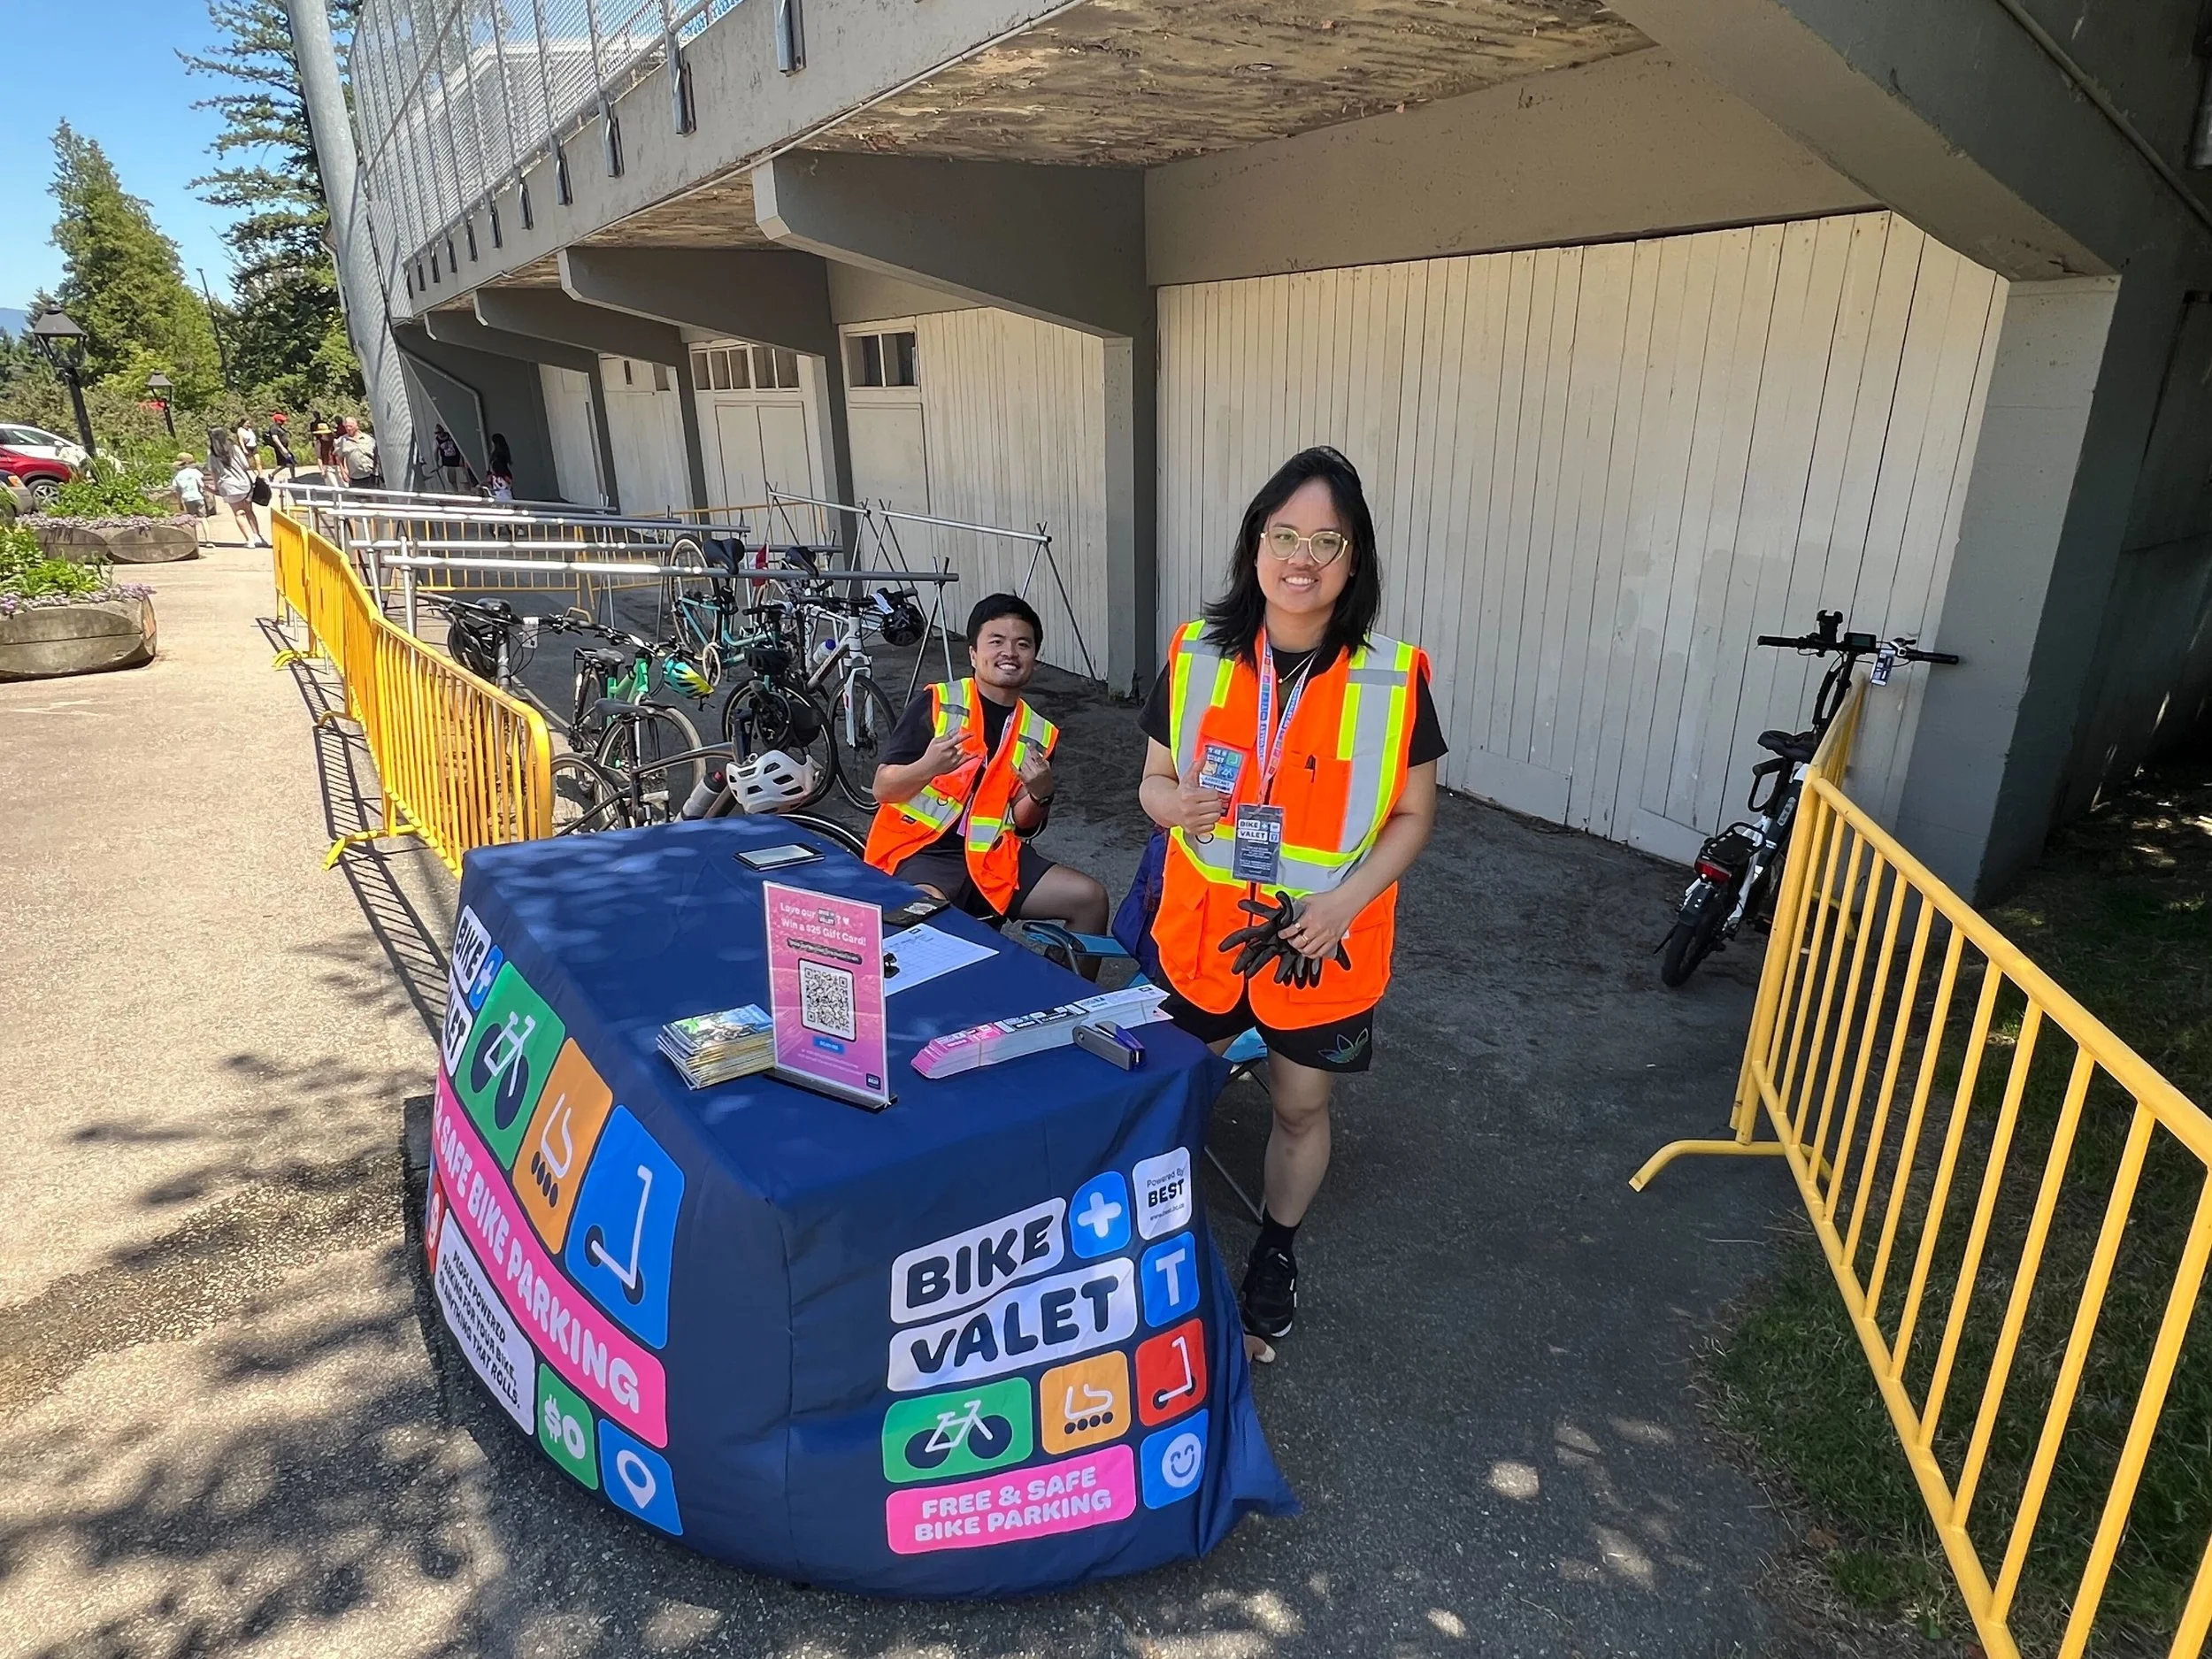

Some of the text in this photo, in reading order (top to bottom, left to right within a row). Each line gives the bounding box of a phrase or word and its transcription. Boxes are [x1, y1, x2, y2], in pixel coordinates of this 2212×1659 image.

[780, 902, 800, 915] Love
[780, 917, 798, 929] Win
[823, 927, 841, 940] Gift
[841, 933, 867, 947] Card!
[455, 916, 485, 980] BIKE
[1147, 1167, 1185, 1187] Powered By
[1148, 1179, 1184, 1208] BEST
[441, 1116, 472, 1198] SAFE
[468, 1171, 509, 1265] BIKE
[507, 1238, 640, 1414] PARKING
[906, 1214, 1054, 1309] BIKE
[442, 1254, 517, 1387] PARKING FOR YOUR BIKE,
[453, 1250, 506, 1343] PEOPLE POWERED
[910, 1275, 1118, 1373] VALET
[444, 1285, 472, 1342] ANYTHING
[472, 1334, 491, 1369] THAT
[491, 1363, 520, 1409] ROLLS.
[543, 1394, 586, 1460] $0
[914, 1489, 1112, 1542] BIKE PARKING
[922, 1465, 1097, 1519] FREE & SAFE
